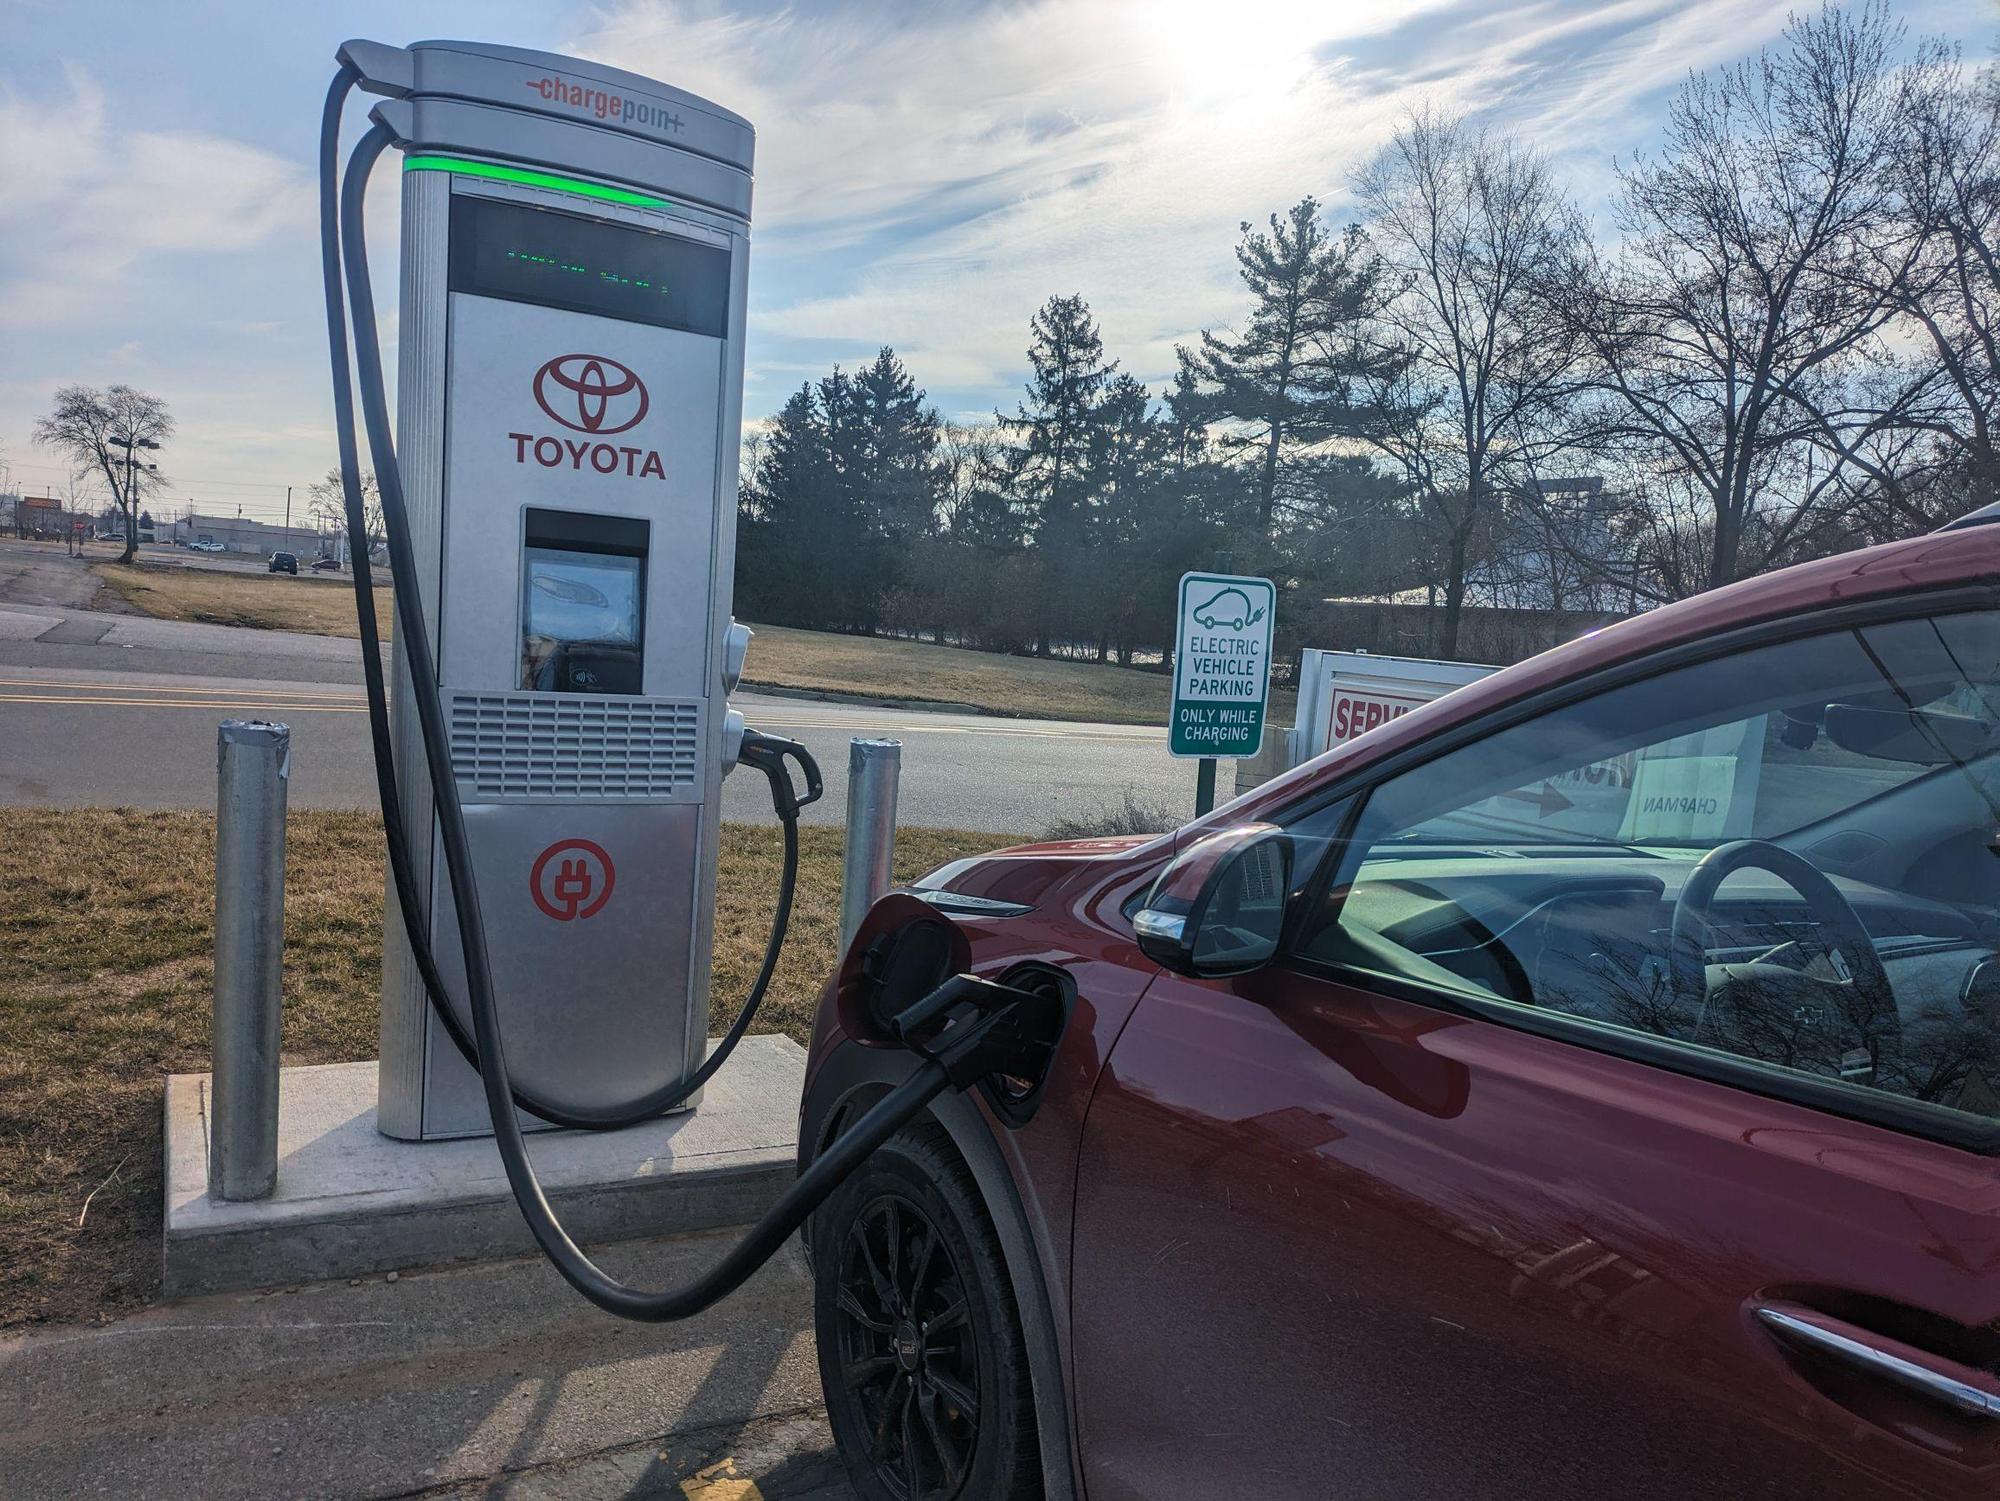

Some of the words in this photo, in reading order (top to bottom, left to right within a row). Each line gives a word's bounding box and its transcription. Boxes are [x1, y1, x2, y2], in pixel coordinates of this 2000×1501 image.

[508, 432, 666, 480] TOYOTA
[1191, 638, 1259, 655] ELECTRIC
[1193, 658, 1255, 675] VEHICLE
[1189, 678, 1254, 695] PARKING
[1180, 708, 1216, 723] ONLY
[1219, 709, 1257, 724] WHILE
[1335, 697, 1408, 739] SER
[1184, 726, 1249, 741] CHARGING
